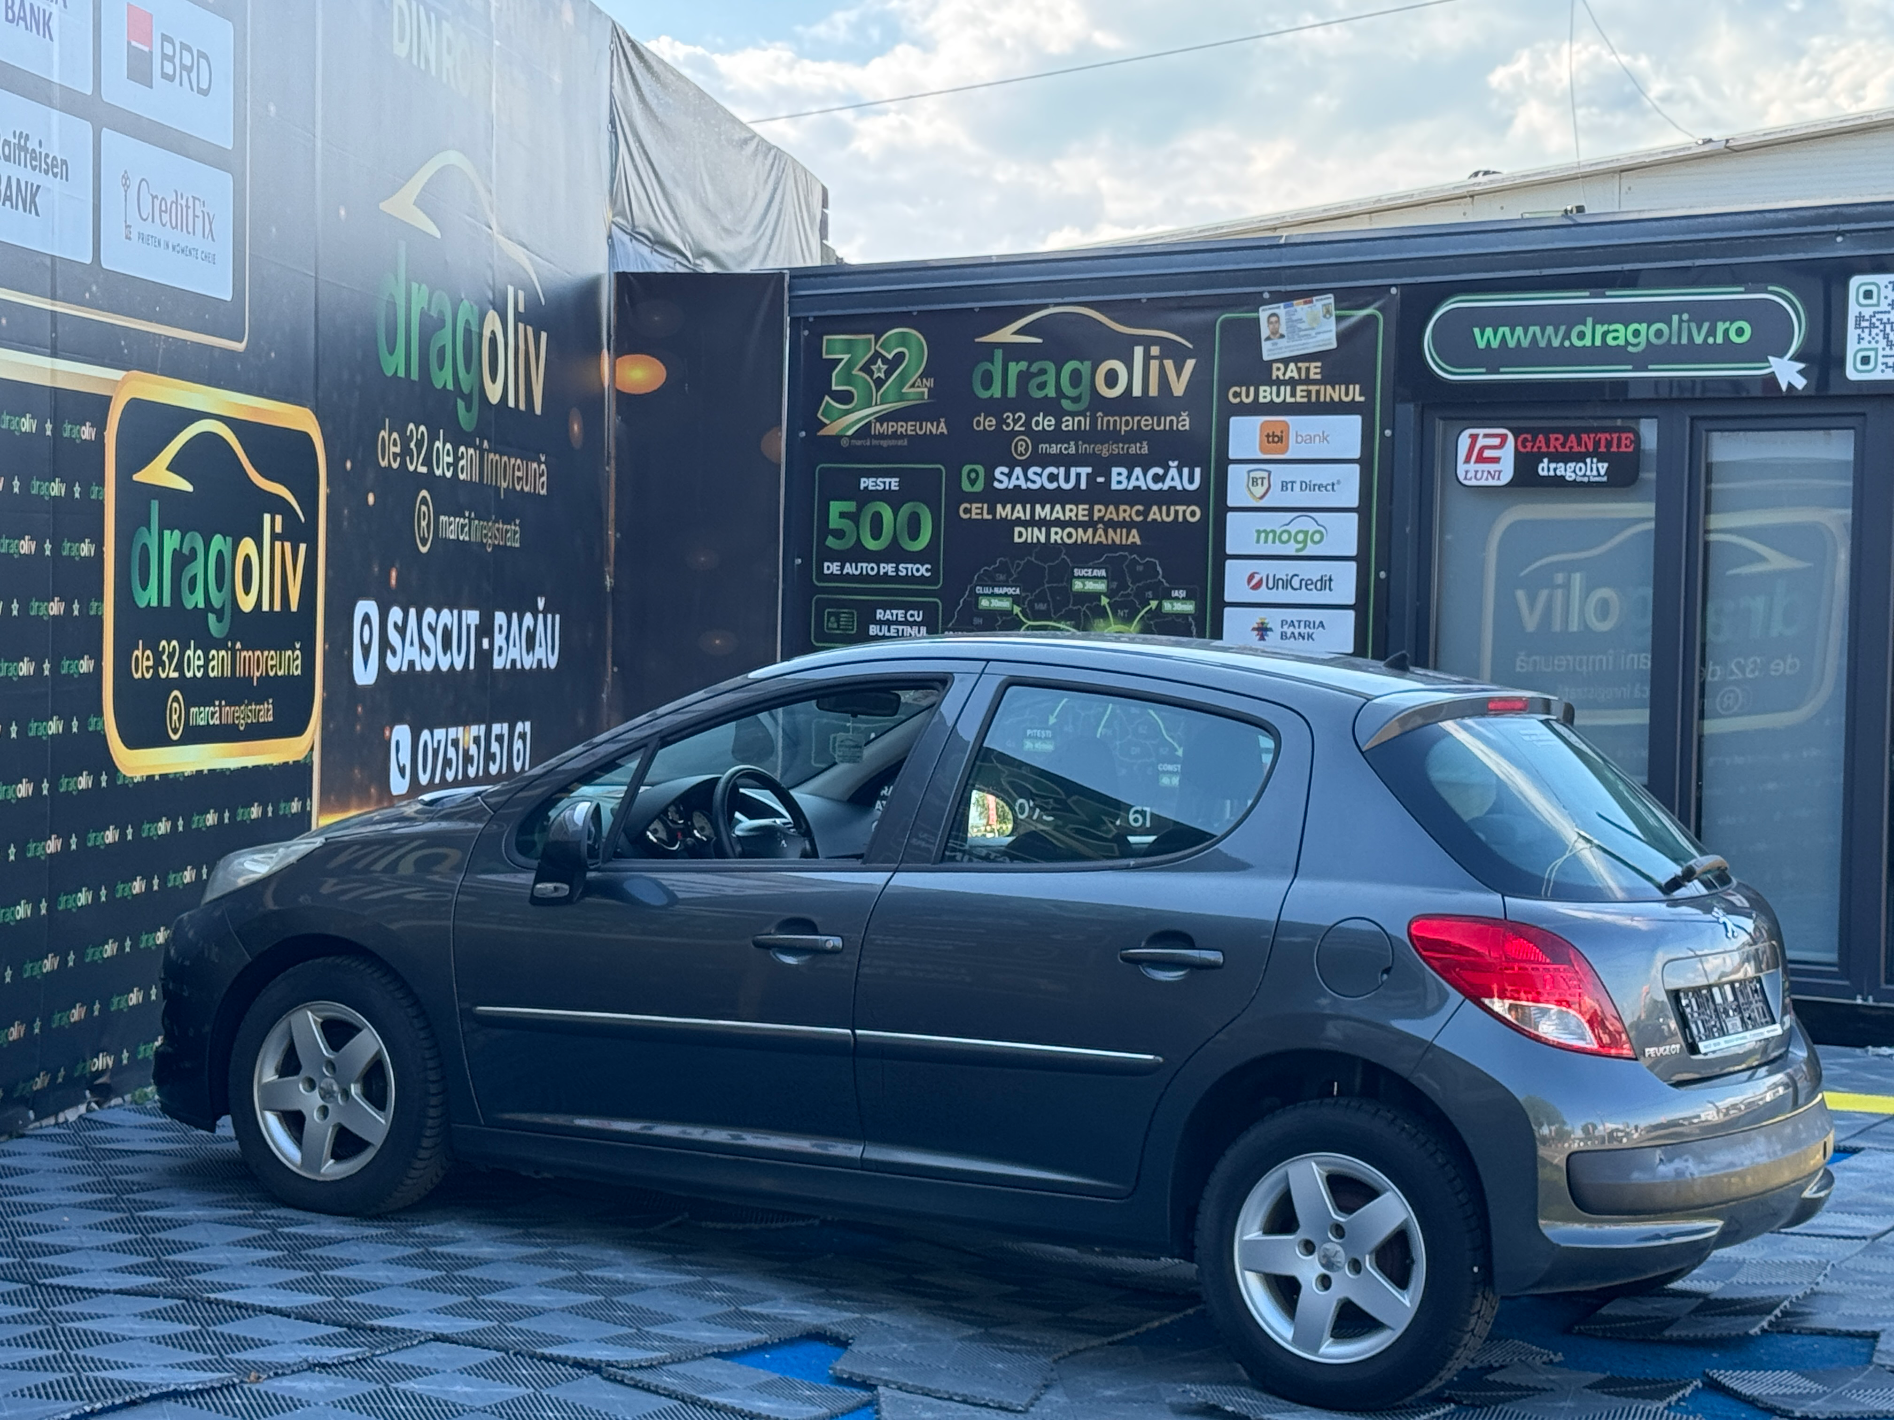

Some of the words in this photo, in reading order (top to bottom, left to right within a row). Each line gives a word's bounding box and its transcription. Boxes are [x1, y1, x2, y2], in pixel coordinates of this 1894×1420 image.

[4, 0, 54, 42] BANK
[392, 0, 436, 77] DIN
[160, 32, 212, 97] BRD
[0, 130, 69, 182] aiffeisen
[137, 178, 215, 242] CreditFix
[376, 240, 547, 432] dragoliv
[1473, 313, 1751, 352] www.dragoliv.ro
[817, 327, 928, 425] 32
[971, 346, 1196, 411] dragoliv
[1271, 362, 1322, 380] RATE
[914, 378, 934, 388] ANI
[1228, 386, 1255, 404] CU
[1258, 384, 1365, 404] BULETINUL
[871, 418, 948, 435] ÎMPREUNĂ
[973, 413, 996, 431] de
[1002, 412, 1026, 431] 32
[1031, 412, 1055, 431] de
[1061, 411, 1090, 431] ani
[1096, 411, 1190, 435] împreună
[1038, 441, 1076, 455] marcă
[1078, 441, 1149, 457] înregistrată
[1265, 431, 1284, 444] tbi
[1295, 431, 1330, 445] bank
[1463, 433, 1509, 464] 12
[1517, 433, 1635, 453] GARANTIE
[377, 418, 401, 469] de
[406, 422, 428, 473] 32
[433, 429, 454, 478] de
[457, 437, 480, 483] ani
[482, 439, 548, 499] împreună
[1537, 458, 1608, 481] dragoliv
[860, 477, 900, 490] PESTE
[993, 467, 1092, 490] SASCUT
[1110, 461, 1201, 491] BACĂU
[1251, 476, 1266, 488] BT
[1463, 470, 1503, 481] LUNI
[1280, 481, 1296, 493] BT
[959, 503, 992, 520] CEL
[996, 504, 1031, 521] MAI
[1034, 504, 1089, 521] MARE
[1093, 505, 1144, 522] PARC
[1147, 505, 1201, 522] AUTO
[439, 510, 470, 541] marcă
[470, 512, 520, 552] înregistrată
[825, 501, 933, 552] 500
[1013, 527, 1046, 543] DIN
[1050, 524, 1141, 545] ROMÂNIA
[1255, 529, 1325, 553] mogo
[130, 500, 307, 638] dragoliv
[823, 562, 841, 575] DE
[843, 562, 877, 576] AUTO
[880, 563, 897, 576] PE
[899, 564, 932, 577] STOC
[1073, 568, 1106, 577] SUCEAVA
[975, 586, 1020, 595] CLUJ-NAPOCA
[1265, 574, 1334, 592] UniCredit
[876, 609, 905, 621] RATE
[906, 610, 923, 622] CU
[1280, 620, 1326, 631] PATRIA
[386, 606, 480, 673] SASCUT
[492, 597, 560, 670] BACĂU
[869, 625, 928, 638] BULETINUL
[1280, 631, 1315, 641] BANK
[131, 639, 154, 679] de
[158, 640, 180, 679] 32
[184, 640, 205, 678] de
[208, 640, 232, 678] ani
[235, 641, 302, 687] împreună
[189, 700, 220, 726] marcă
[221, 698, 273, 731] înregistrată
[417, 728, 463, 785] 0751
[467, 724, 486, 781] 51
[489, 722, 509, 776] 51
[512, 720, 532, 773] 61
[1158, 763, 1181, 772] CONST
[1644, 1043, 1681, 1058] PEUGEOT
